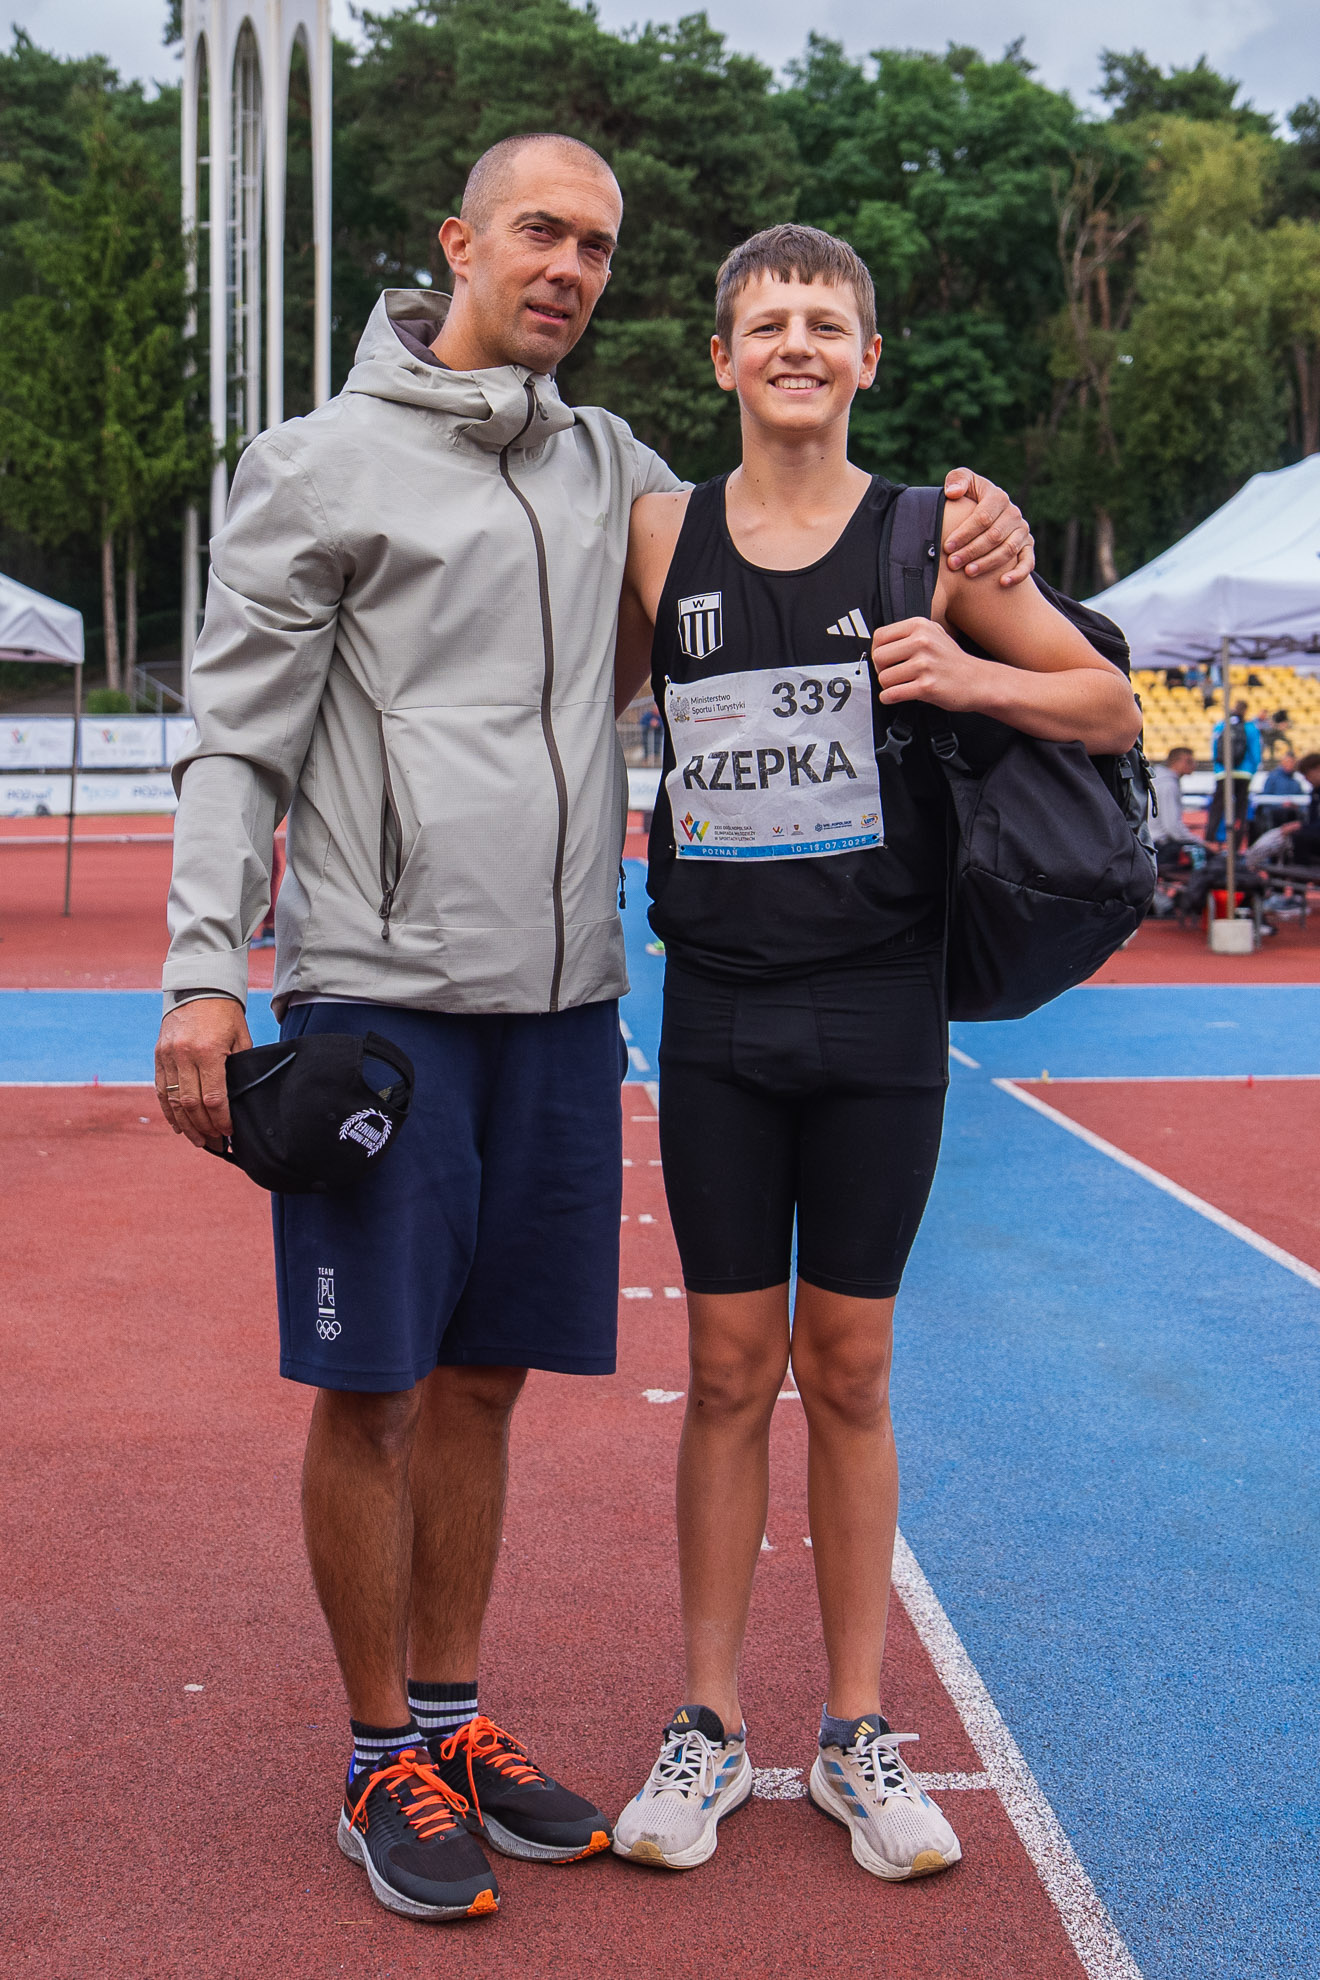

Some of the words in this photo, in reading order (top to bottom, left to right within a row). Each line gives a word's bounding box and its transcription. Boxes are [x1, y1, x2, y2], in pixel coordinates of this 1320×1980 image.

[693, 599, 705, 608] W
[690, 694, 731, 704] Ministerstwo
[771, 677, 852, 718] 339
[692, 705, 712, 715] Sportu
[716, 702, 745, 712] Turystyki
[682, 741, 858, 791] RZEPKA
[702, 847, 738, 856] POZNAŃ
[354, 1120, 382, 1143] WINNER
[318, 1267, 334, 1276] TEAM
